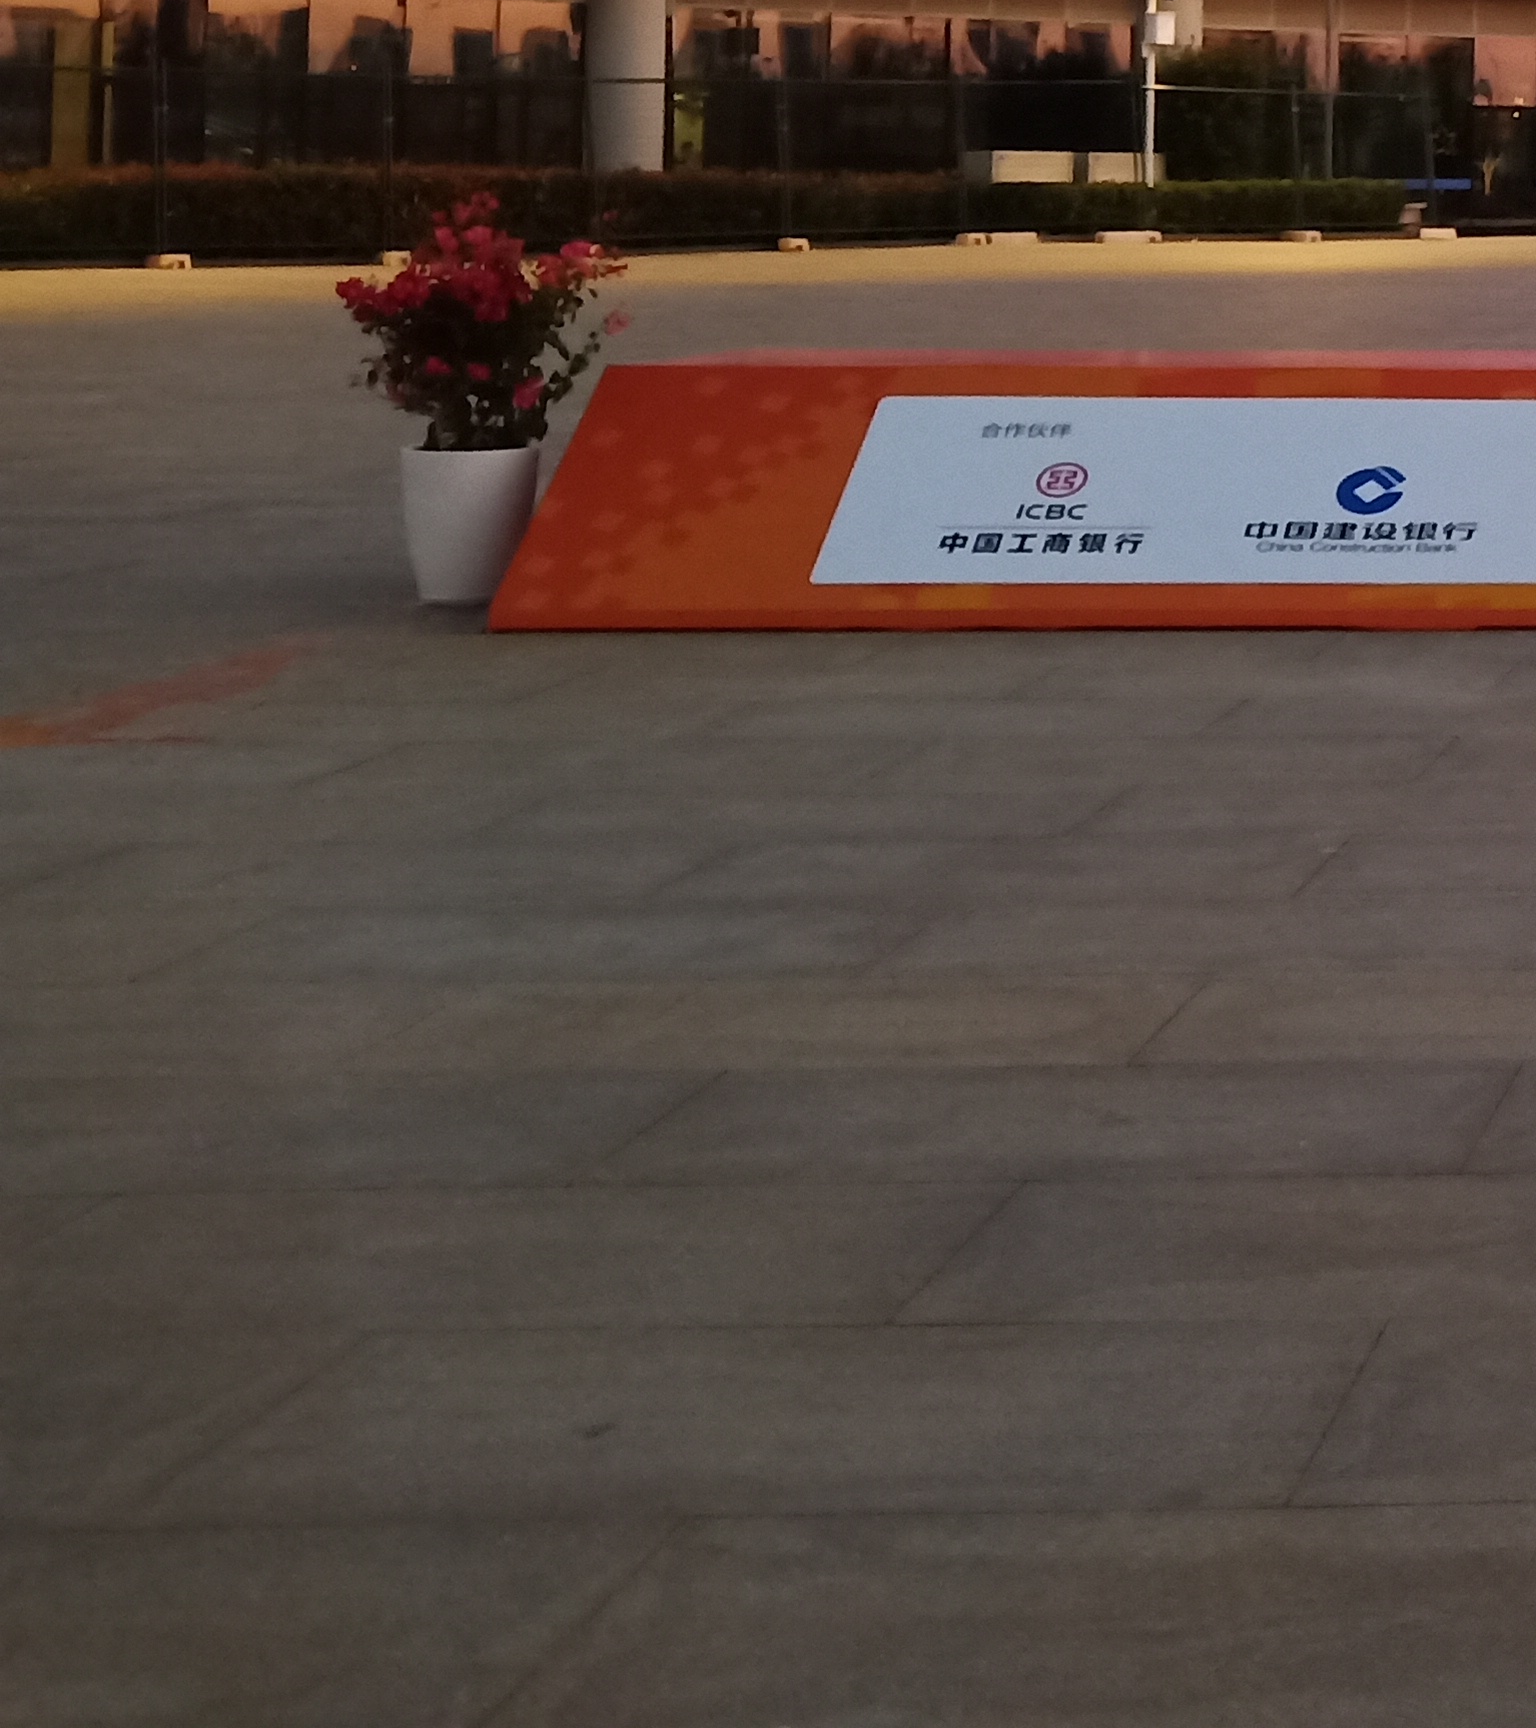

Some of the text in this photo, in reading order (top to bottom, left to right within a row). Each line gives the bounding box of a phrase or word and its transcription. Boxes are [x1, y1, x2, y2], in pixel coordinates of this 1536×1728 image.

[1016, 504, 1088, 520] ICBC
[1244, 521, 1478, 541] 中国建设银行
[937, 532, 1145, 554] 中国工商银行
